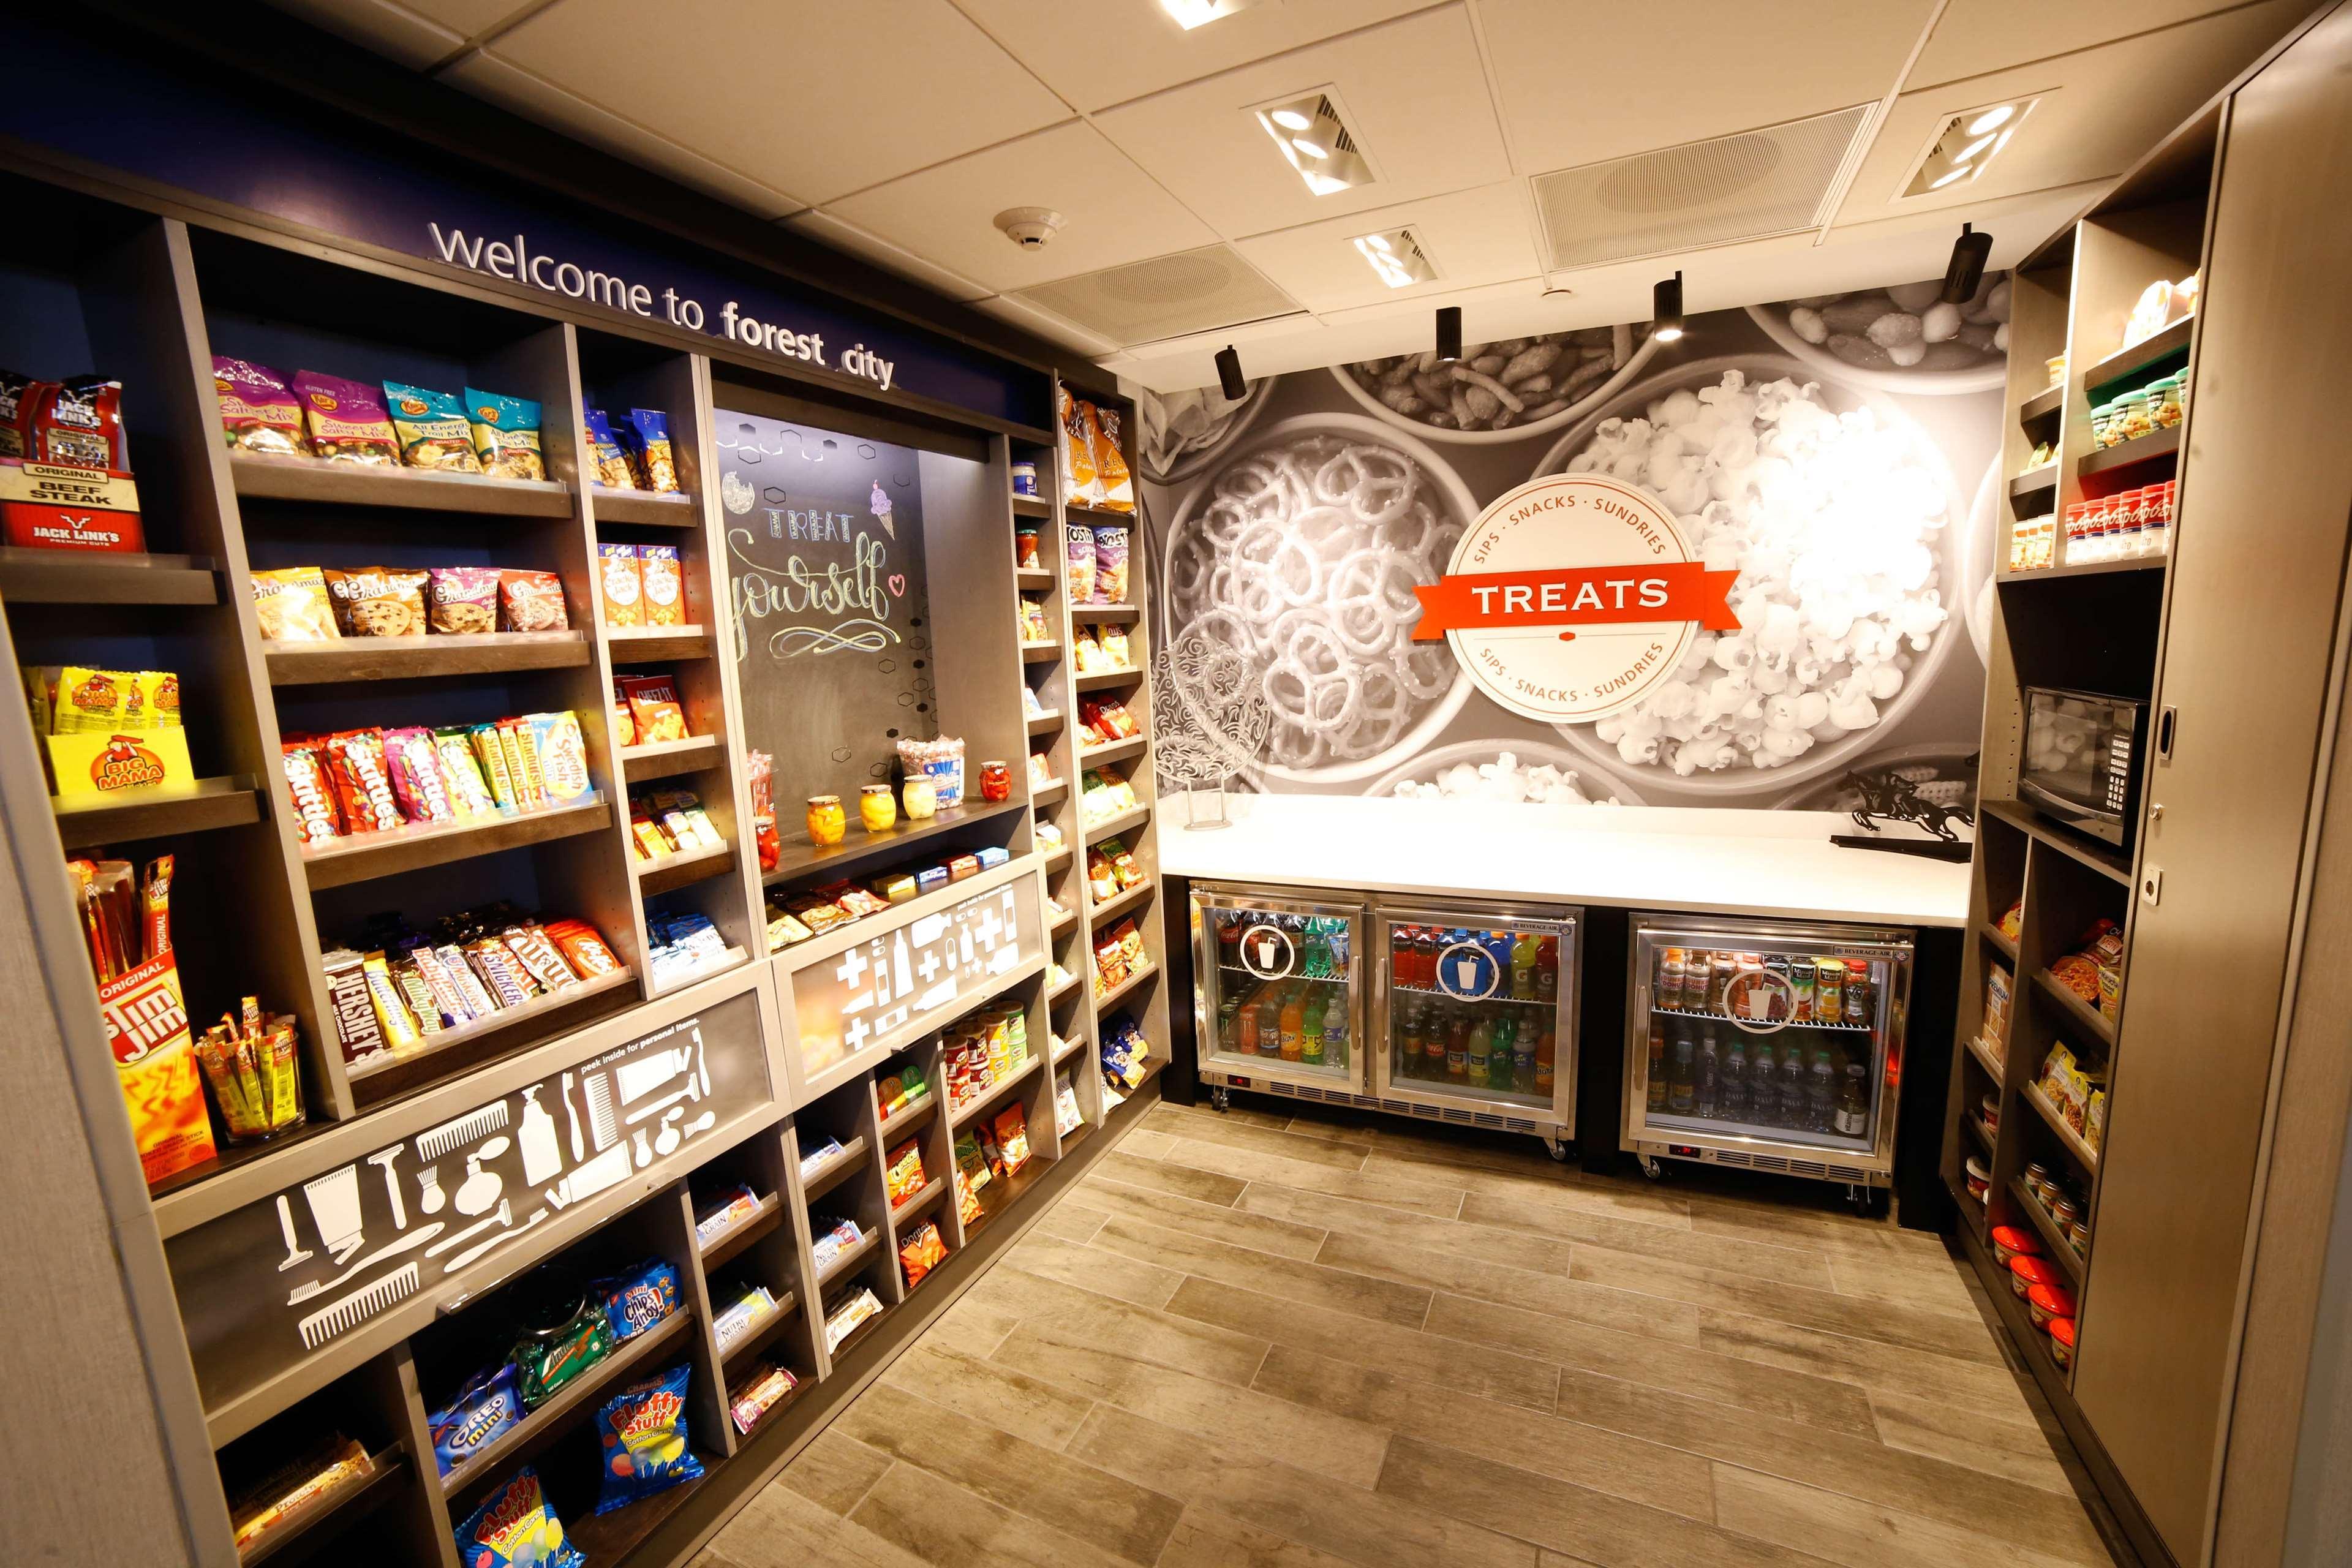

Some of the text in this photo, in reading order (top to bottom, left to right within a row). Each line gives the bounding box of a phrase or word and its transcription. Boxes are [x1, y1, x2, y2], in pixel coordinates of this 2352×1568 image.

[428, 222, 894, 391] welcome to forest city
[306, 385, 323, 394] GLUTEN
[34, 466, 101, 481] ORIGINAL
[39, 481, 101, 494] BEEF
[29, 490, 112, 506] STEAK
[34, 526, 120, 543] JACK LINK'S
[764, 507, 854, 543] TREAT
[1474, 495, 1666, 564] SIPS SNACKS SUNDRIES
[728, 529, 889, 662] yourself
[1471, 578, 1669, 615] TREATS
[1480, 642, 1663, 702] SIPS SNACKS SUNDRIES
[98, 766, 164, 791] MAMA
[106, 758, 145, 774] BIG
[553, 753, 570, 782] Fish
[556, 739, 584, 790] Swedish
[156, 914, 167, 955] ORIGINAL
[100, 962, 165, 999] ORIGINAL
[402, 978, 442, 1035] Milky Way
[124, 1009, 188, 1063] Jim
[335, 1014, 348, 1044] CHOCOLATE
[581, 1017, 700, 1076] peek inside for personal items.
[901, 1221, 932, 1248] Doritos
[624, 1293, 655, 1321] Chips
[633, 1288, 664, 1330] Ahoy!
[450, 1396, 505, 1449] OREO
[467, 1409, 503, 1447] mini
[609, 1391, 684, 1430] Fluffy
[624, 1411, 667, 1437] Stuff
[626, 1433, 652, 1447] Cotton
[275, 1482, 317, 1513] Protein
[474, 1475, 538, 1546] Fluffy
[492, 1495, 531, 1544] Stuff
[501, 1508, 545, 1555] Cotton Candy
